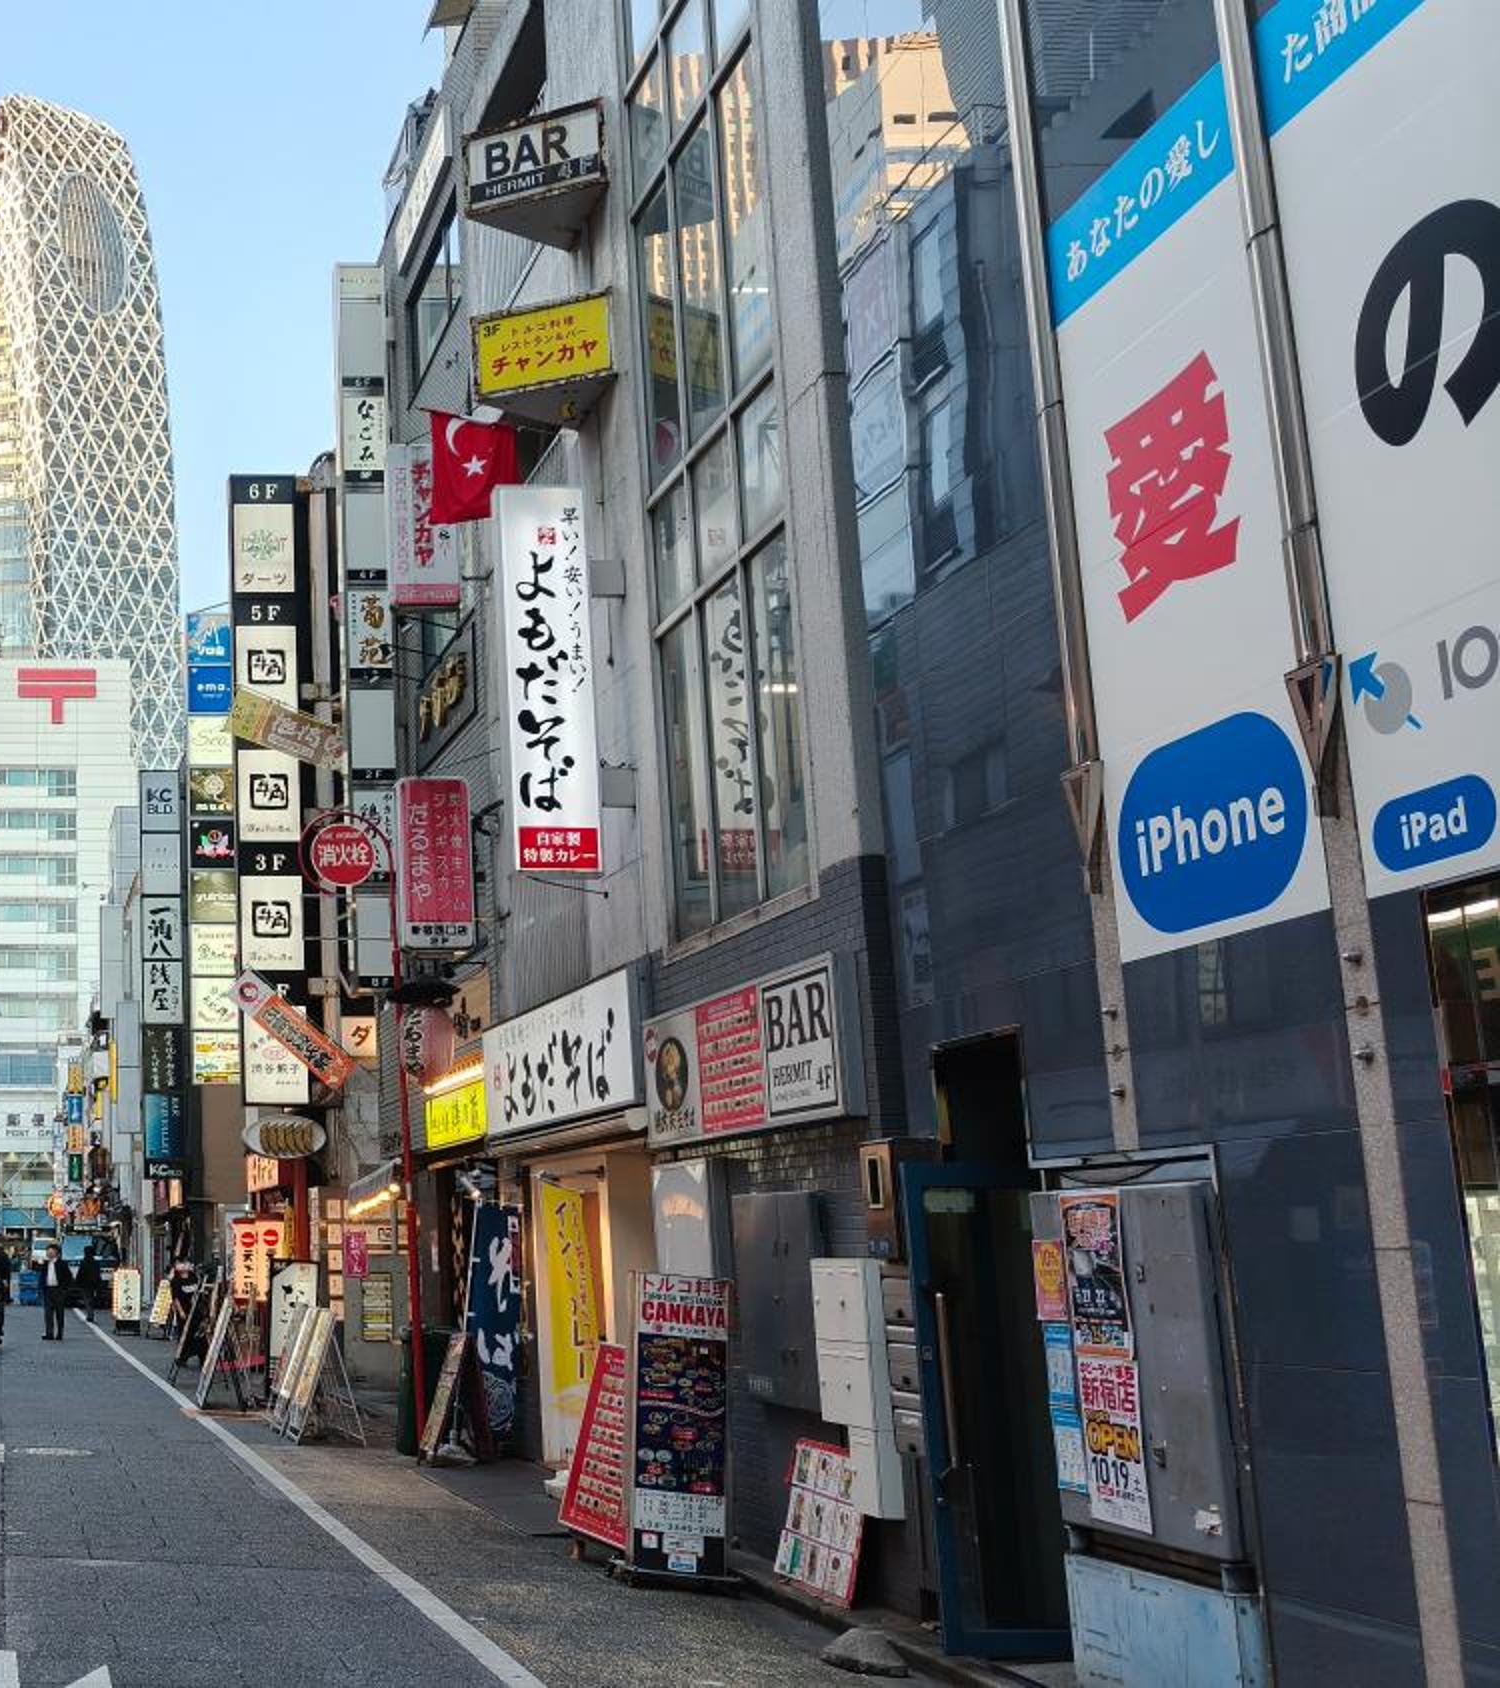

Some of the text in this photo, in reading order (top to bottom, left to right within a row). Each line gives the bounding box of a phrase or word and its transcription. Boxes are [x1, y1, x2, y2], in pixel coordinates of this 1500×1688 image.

[484, 125, 571, 181] BAR
[485, 171, 546, 197] HERMIT
[483, 324, 501, 338] 3F
[510, 315, 576, 337] トルコ料理
[1355, 199, 1500, 447] の
[491, 339, 599, 377] チャンカヤ
[1104, 349, 1243, 624] 愛
[516, 550, 576, 812] よもだそば
[147, 788, 173, 802] KC
[536, 830, 581, 846] 自家製
[1134, 787, 1286, 878] iPhone
[1400, 795, 1468, 852] iPad
[255, 854, 287, 871] 3F
[318, 844, 370, 867] 消火栓
[522, 847, 597, 864] 特製カレー
[765, 981, 831, 1051] BAR
[503, 1007, 615, 1123] よもだそば
[772, 1059, 833, 1091] HERMIT 4F
[1081, 1376, 1137, 1414] 新宿店
[1086, 1420, 1141, 1465] OPEN
